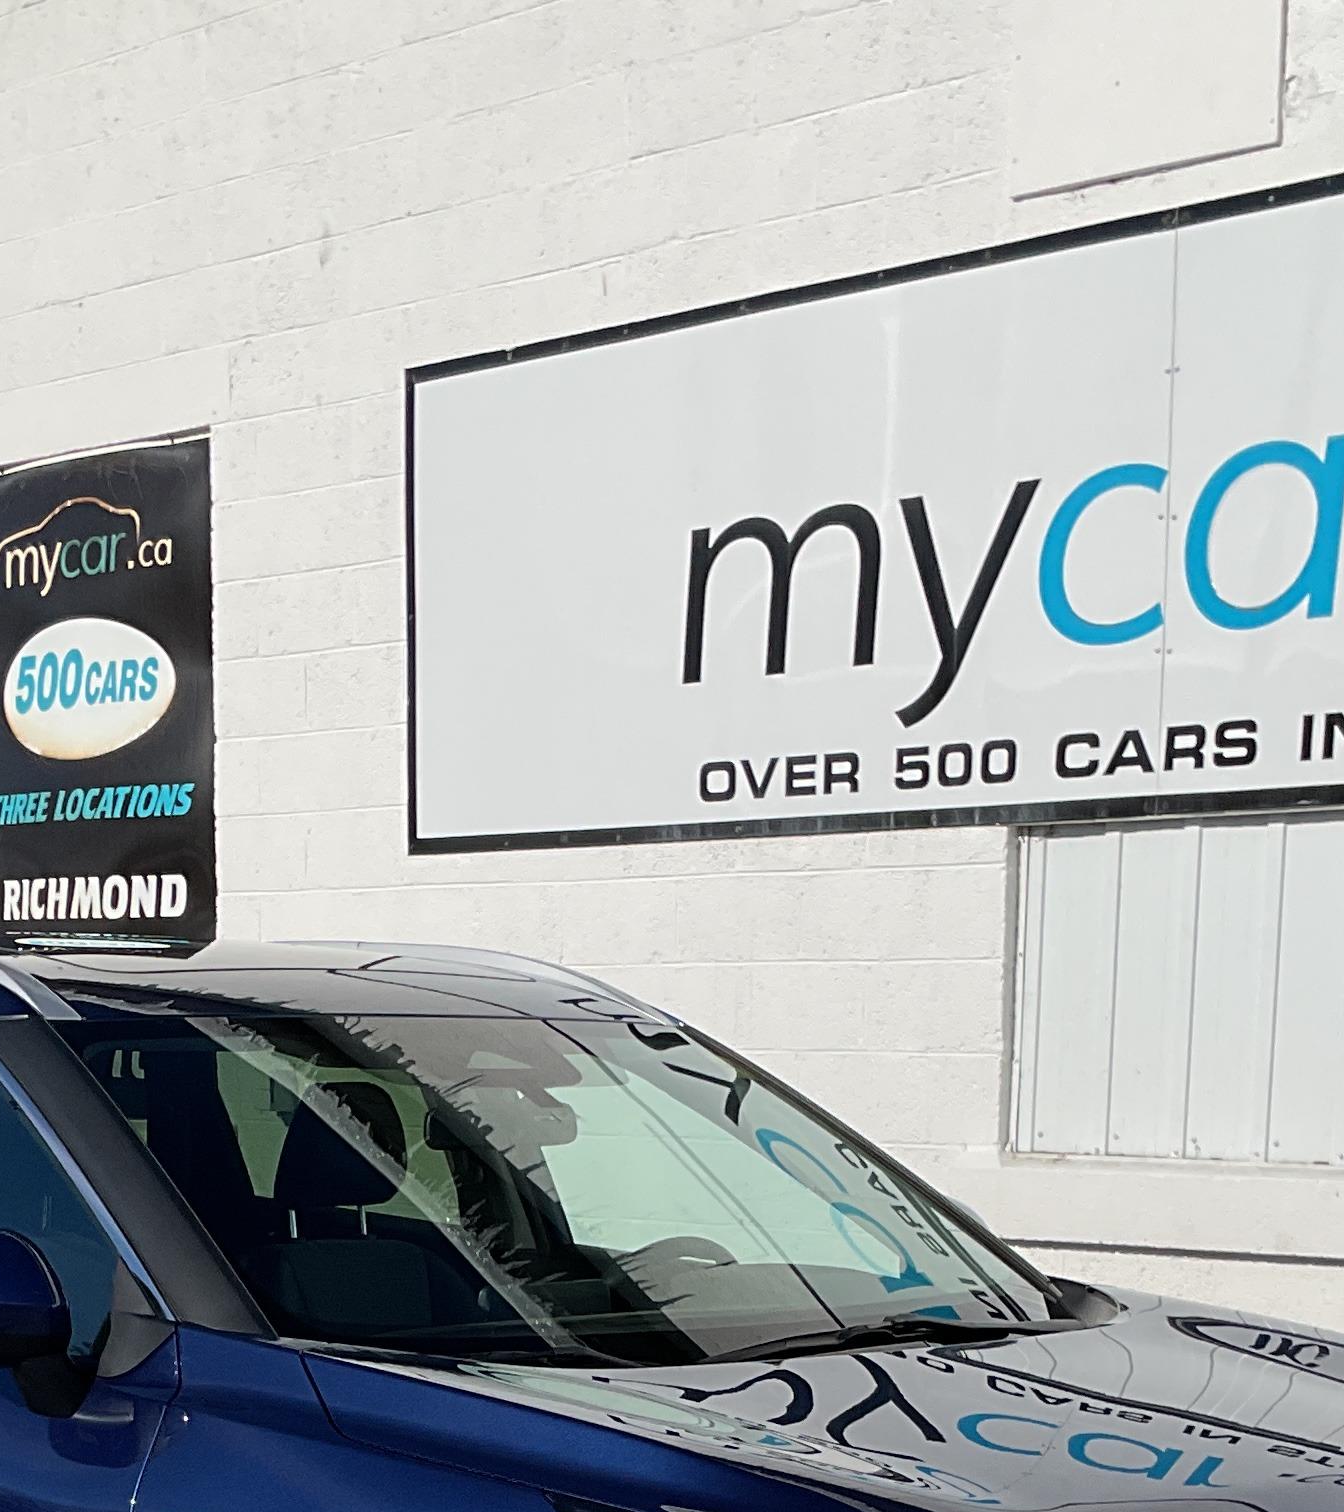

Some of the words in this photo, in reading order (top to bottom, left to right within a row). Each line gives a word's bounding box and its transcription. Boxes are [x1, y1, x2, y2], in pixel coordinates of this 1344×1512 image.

[6, 532, 173, 597] mycar.ca
[699, 752, 860, 803] OVER
[894, 739, 1017, 789] 500
[1055, 719, 1258, 778] CARS
[53, 783, 195, 821] LOCATIONS
[3, 874, 188, 921] RICHMOND
